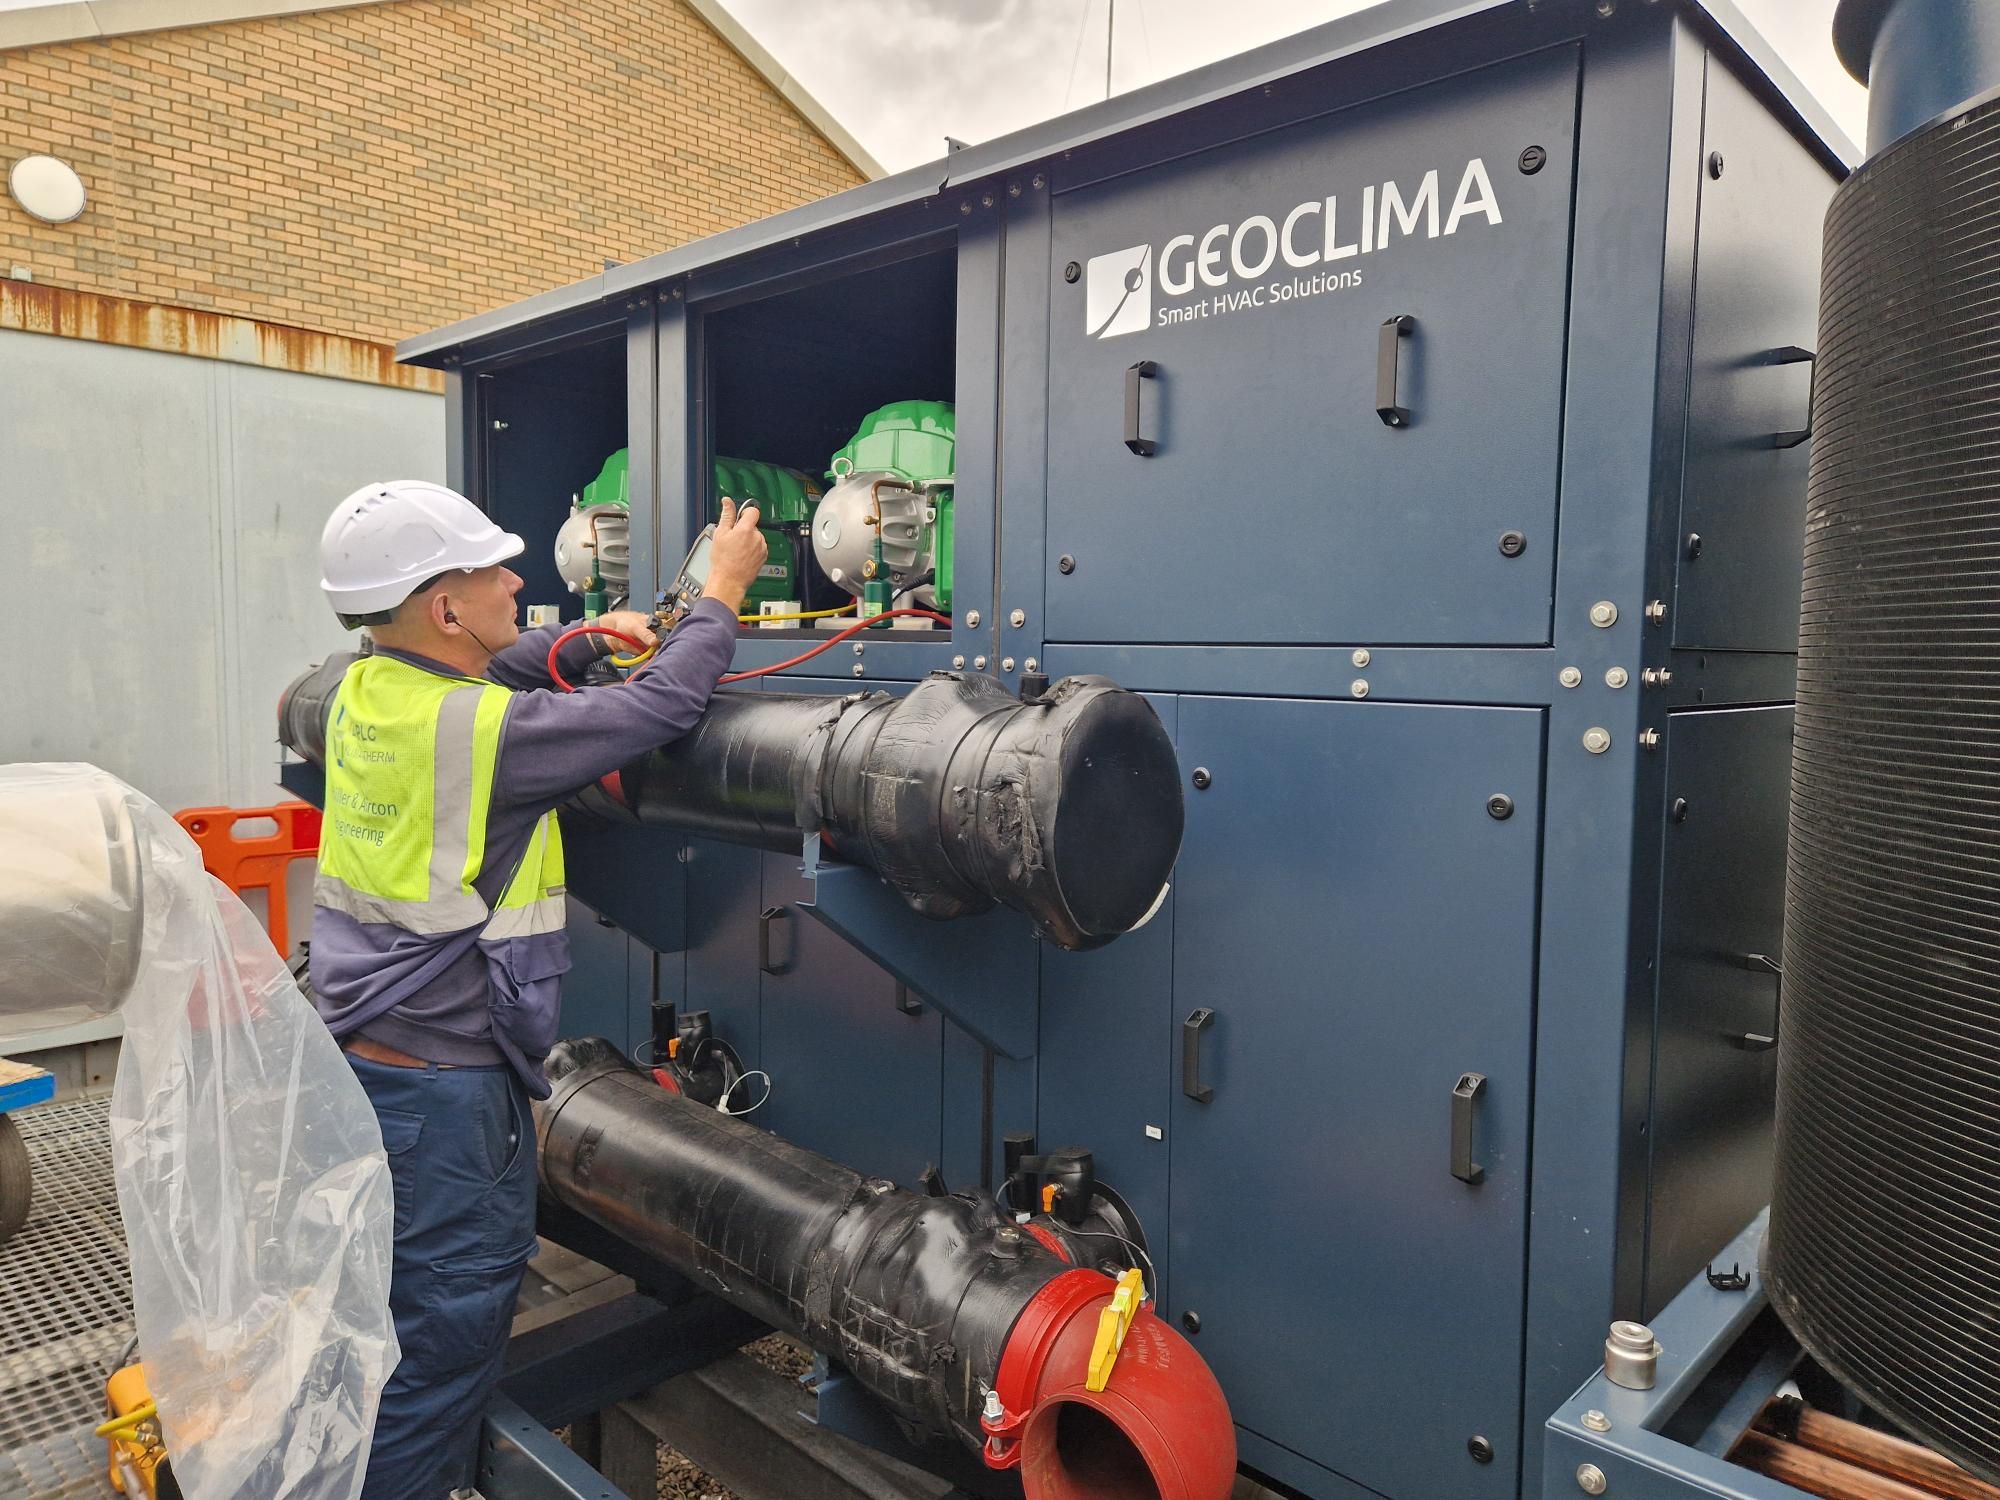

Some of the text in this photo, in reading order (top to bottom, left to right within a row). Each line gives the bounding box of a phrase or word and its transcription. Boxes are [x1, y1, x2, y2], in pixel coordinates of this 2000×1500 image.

[1159, 158, 1503, 295] GEOCLIMA
[1158, 269, 1362, 327] Smart HVAC Solutions
[359, 797, 398, 817] Aircon
